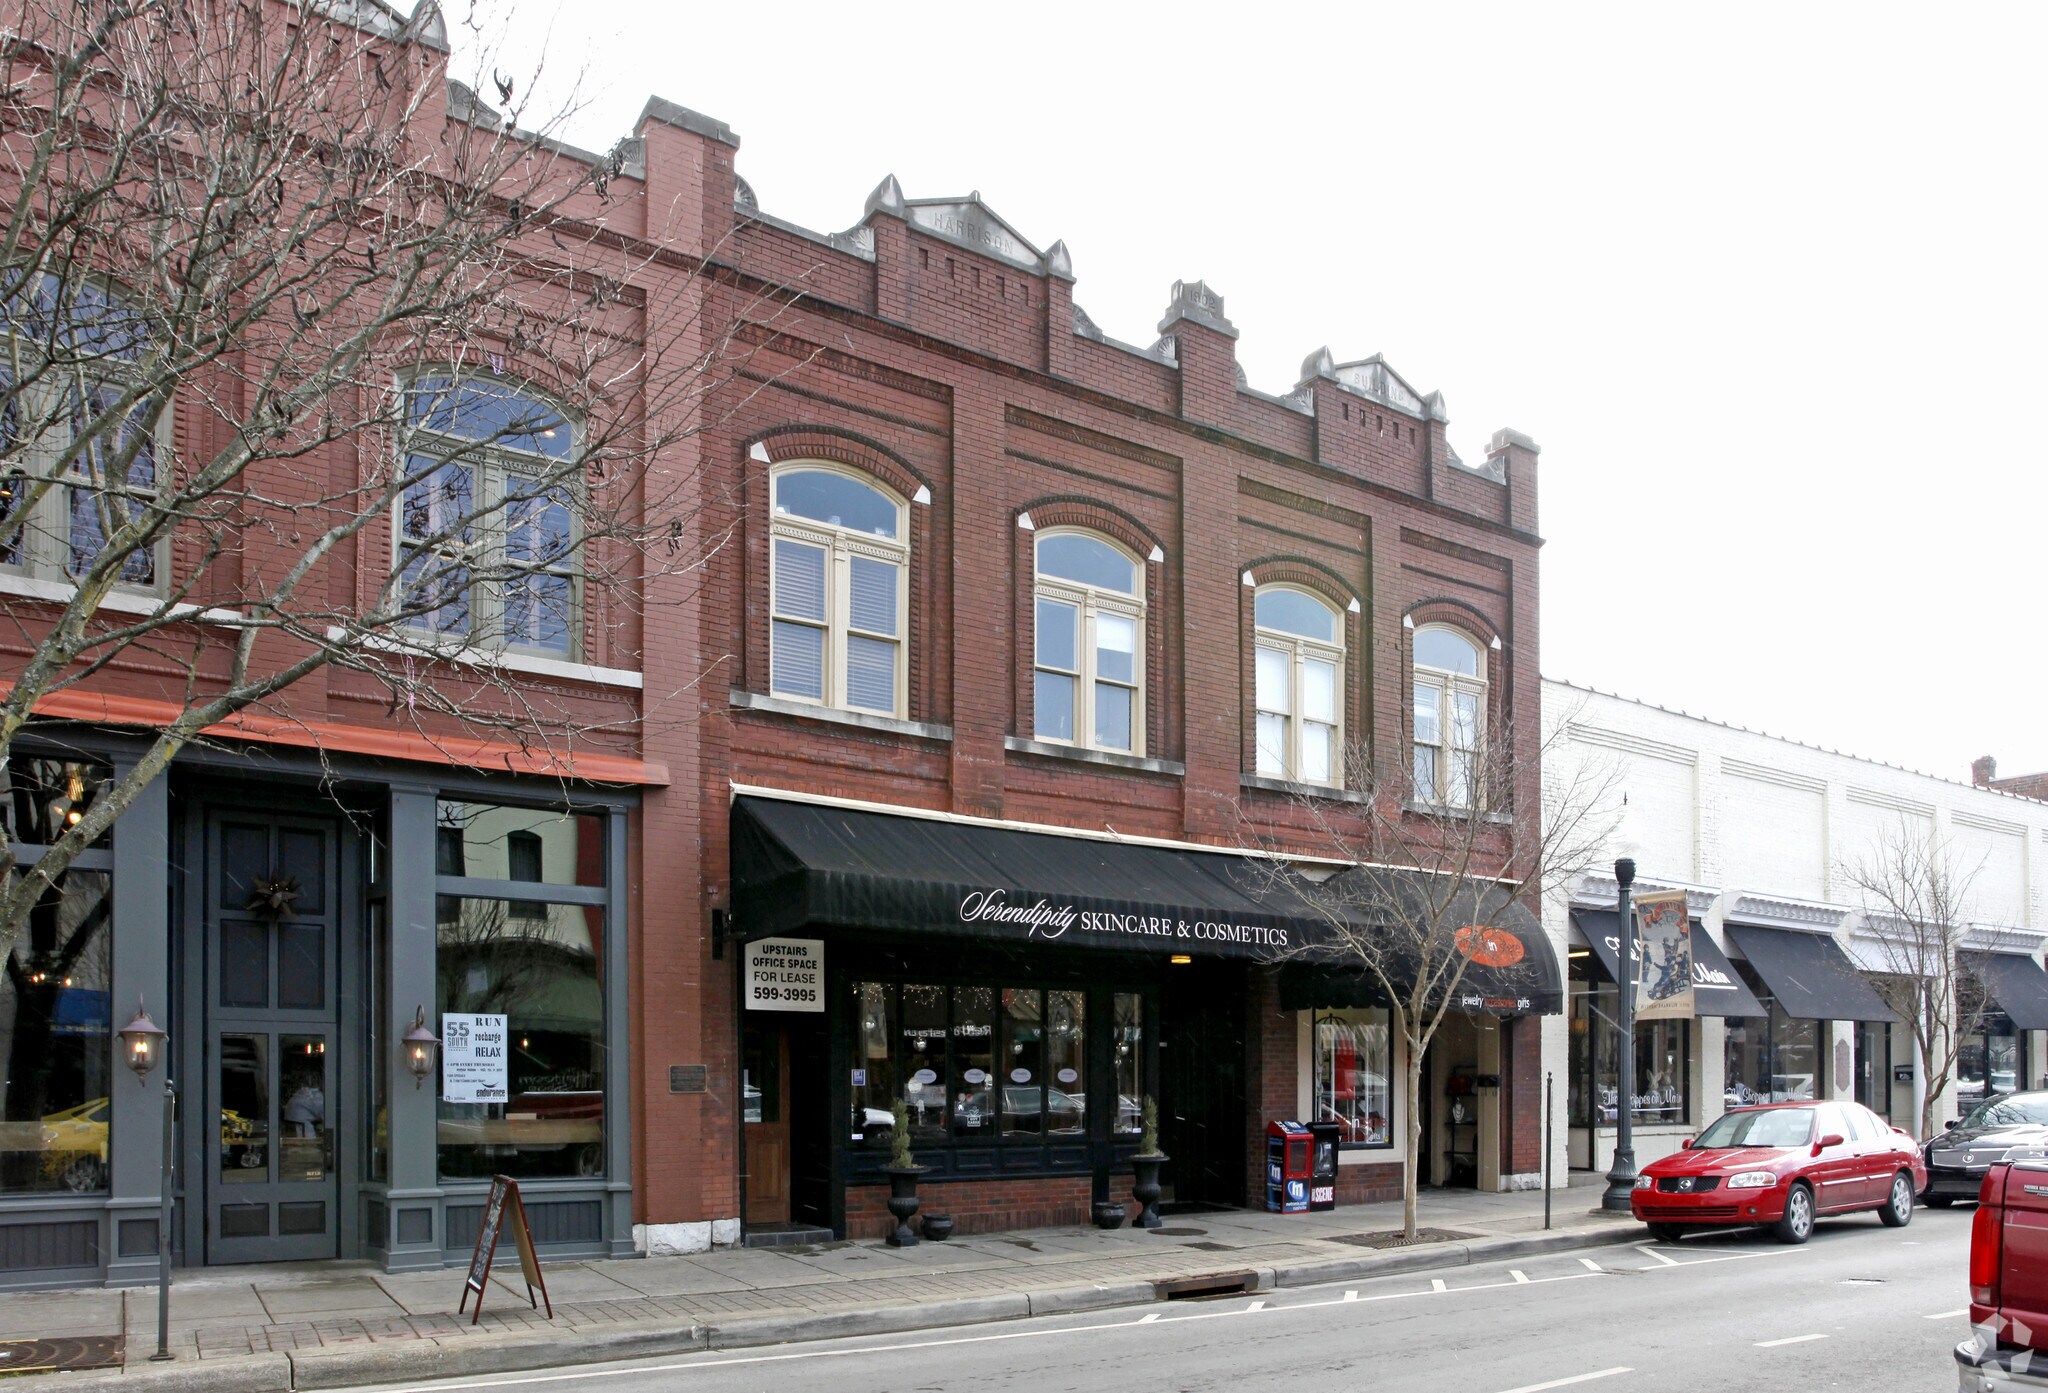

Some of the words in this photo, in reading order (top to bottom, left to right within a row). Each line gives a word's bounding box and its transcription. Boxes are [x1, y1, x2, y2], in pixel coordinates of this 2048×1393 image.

[934, 212, 1013, 255] HARRISON
[1354, 373, 1404, 401] BUILDING
[960, 889, 1077, 939] Serendipity
[1081, 911, 1172, 937] SKINCARE
[1176, 920, 1191, 938] &
[1194, 921, 1288, 946] COSMETICS
[762, 945, 807, 956] UPSTAIRS
[752, 957, 785, 968] OFFICE
[788, 959, 817, 969] SPACE
[754, 971, 777, 982] FOR
[780, 972, 815, 984] LEASE
[1692, 963, 1731, 984] Main
[753, 987, 816, 1002] 599-3995
[1461, 993, 1484, 1008] jewelry
[1517, 997, 1530, 1010] gifts
[475, 1017, 501, 1027] RUN
[446, 1021, 470, 1037] 55
[447, 1037, 468, 1047] SOUTH
[475, 1032, 501, 1044] recharge
[475, 1047, 501, 1058] RELAX
[476, 1088, 505, 1097] endurance
[1351, 1116, 1360, 1129] in
[1315, 1186, 1333, 1203] SCENE
